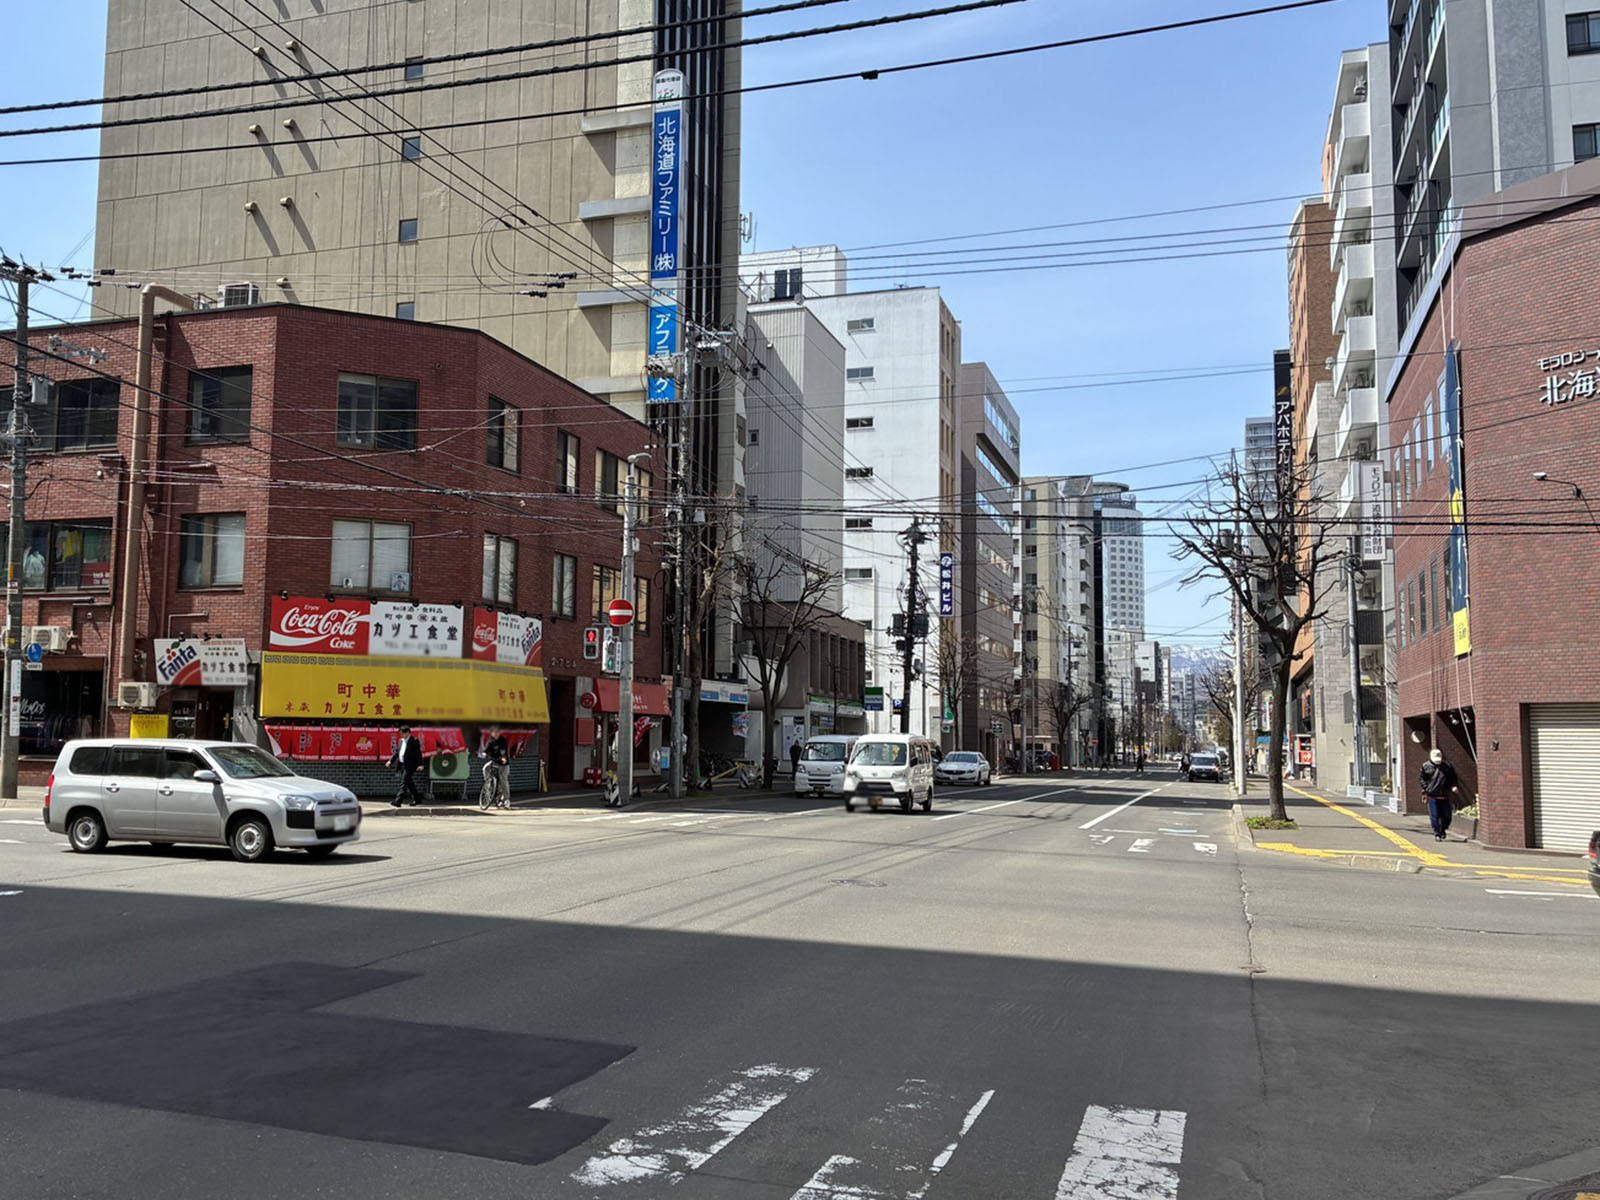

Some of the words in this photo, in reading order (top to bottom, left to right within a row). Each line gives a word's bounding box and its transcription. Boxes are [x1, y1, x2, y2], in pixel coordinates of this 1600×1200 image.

[655, 313, 671, 394] アフラク
[1537, 349, 1600, 370] モラロジー
[1276, 401, 1291, 465] アパホテル
[280, 607, 361, 636] Coca-Cola
[329, 637, 356, 649] Coke
[157, 644, 198, 682] Fanta
[337, 683, 401, 700] 町中華
